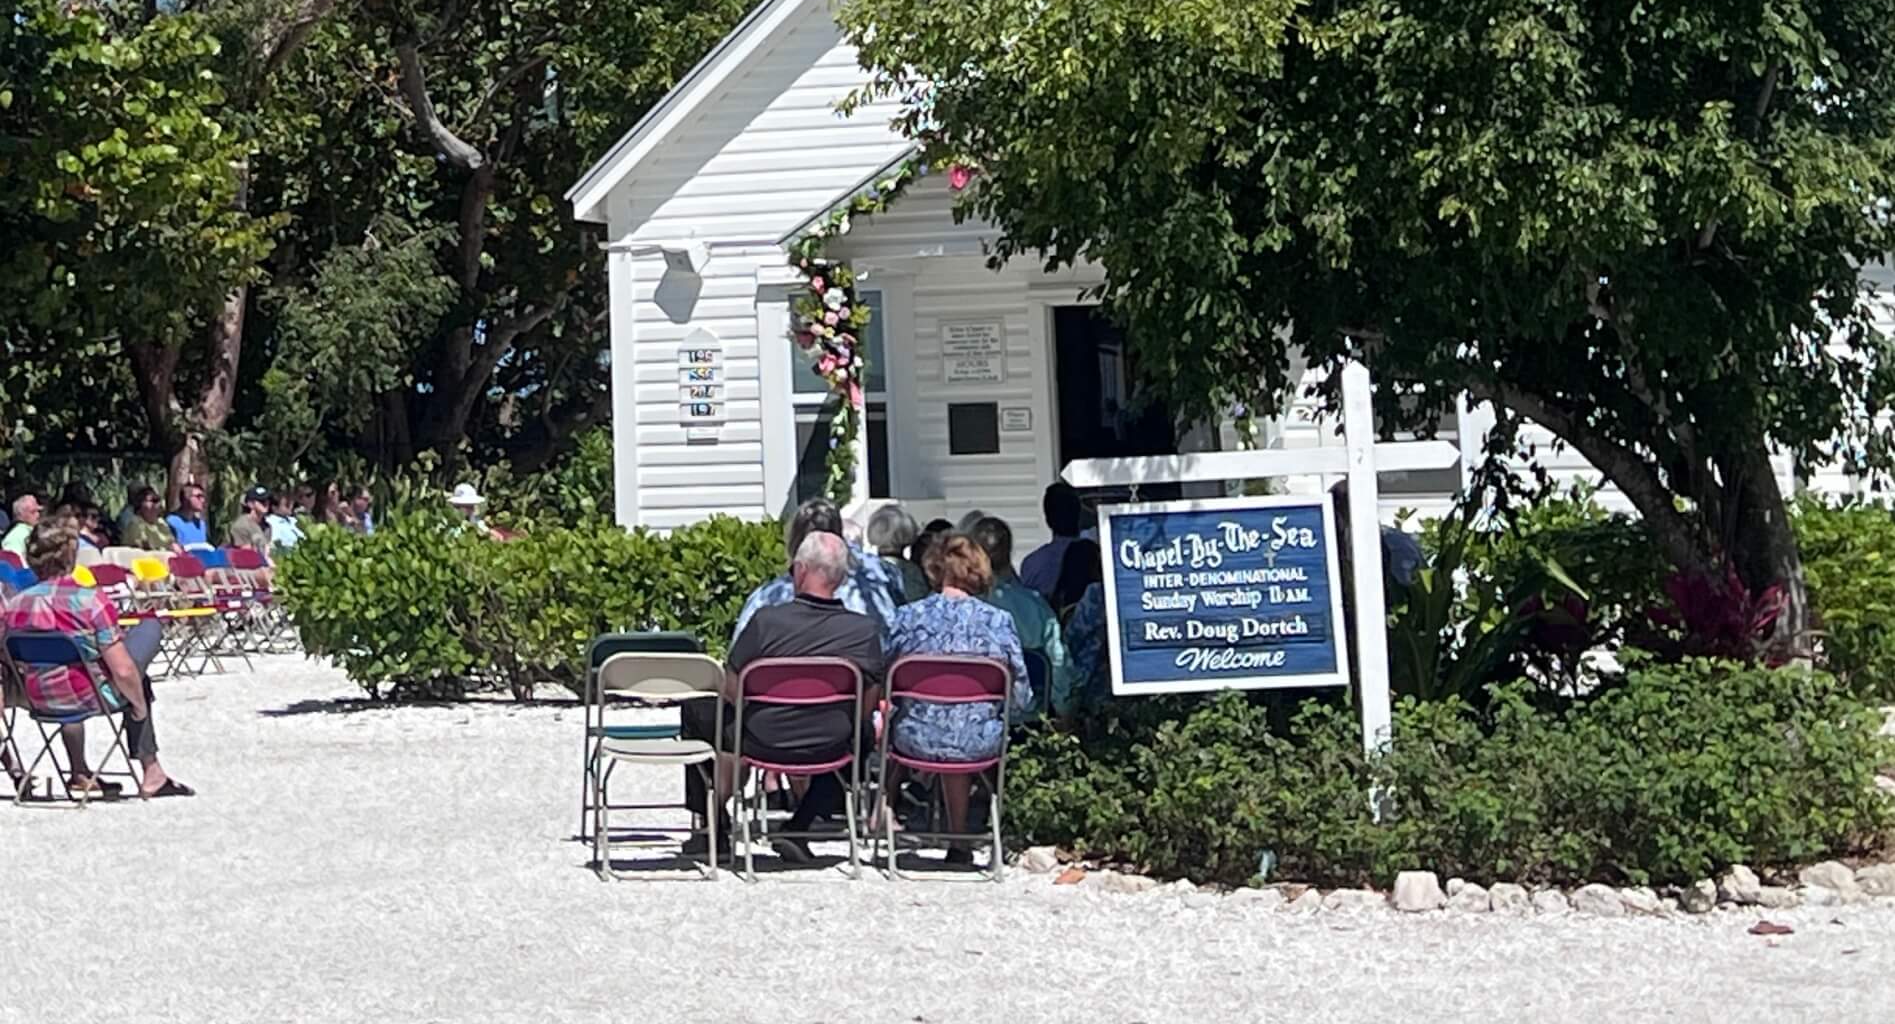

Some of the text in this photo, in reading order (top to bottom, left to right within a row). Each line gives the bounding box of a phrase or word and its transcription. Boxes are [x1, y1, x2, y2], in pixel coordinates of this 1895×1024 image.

[1119, 515, 1318, 572] Chapel-By-The-Sea
[1142, 567, 1309, 589] INTER-DENOMINATIONAL
[1141, 591, 1198, 613] Sunday
[1200, 587, 1263, 609] Worship
[1144, 616, 1309, 644] Rev. Doug Dortch
[1175, 647, 1287, 672] Welcome
